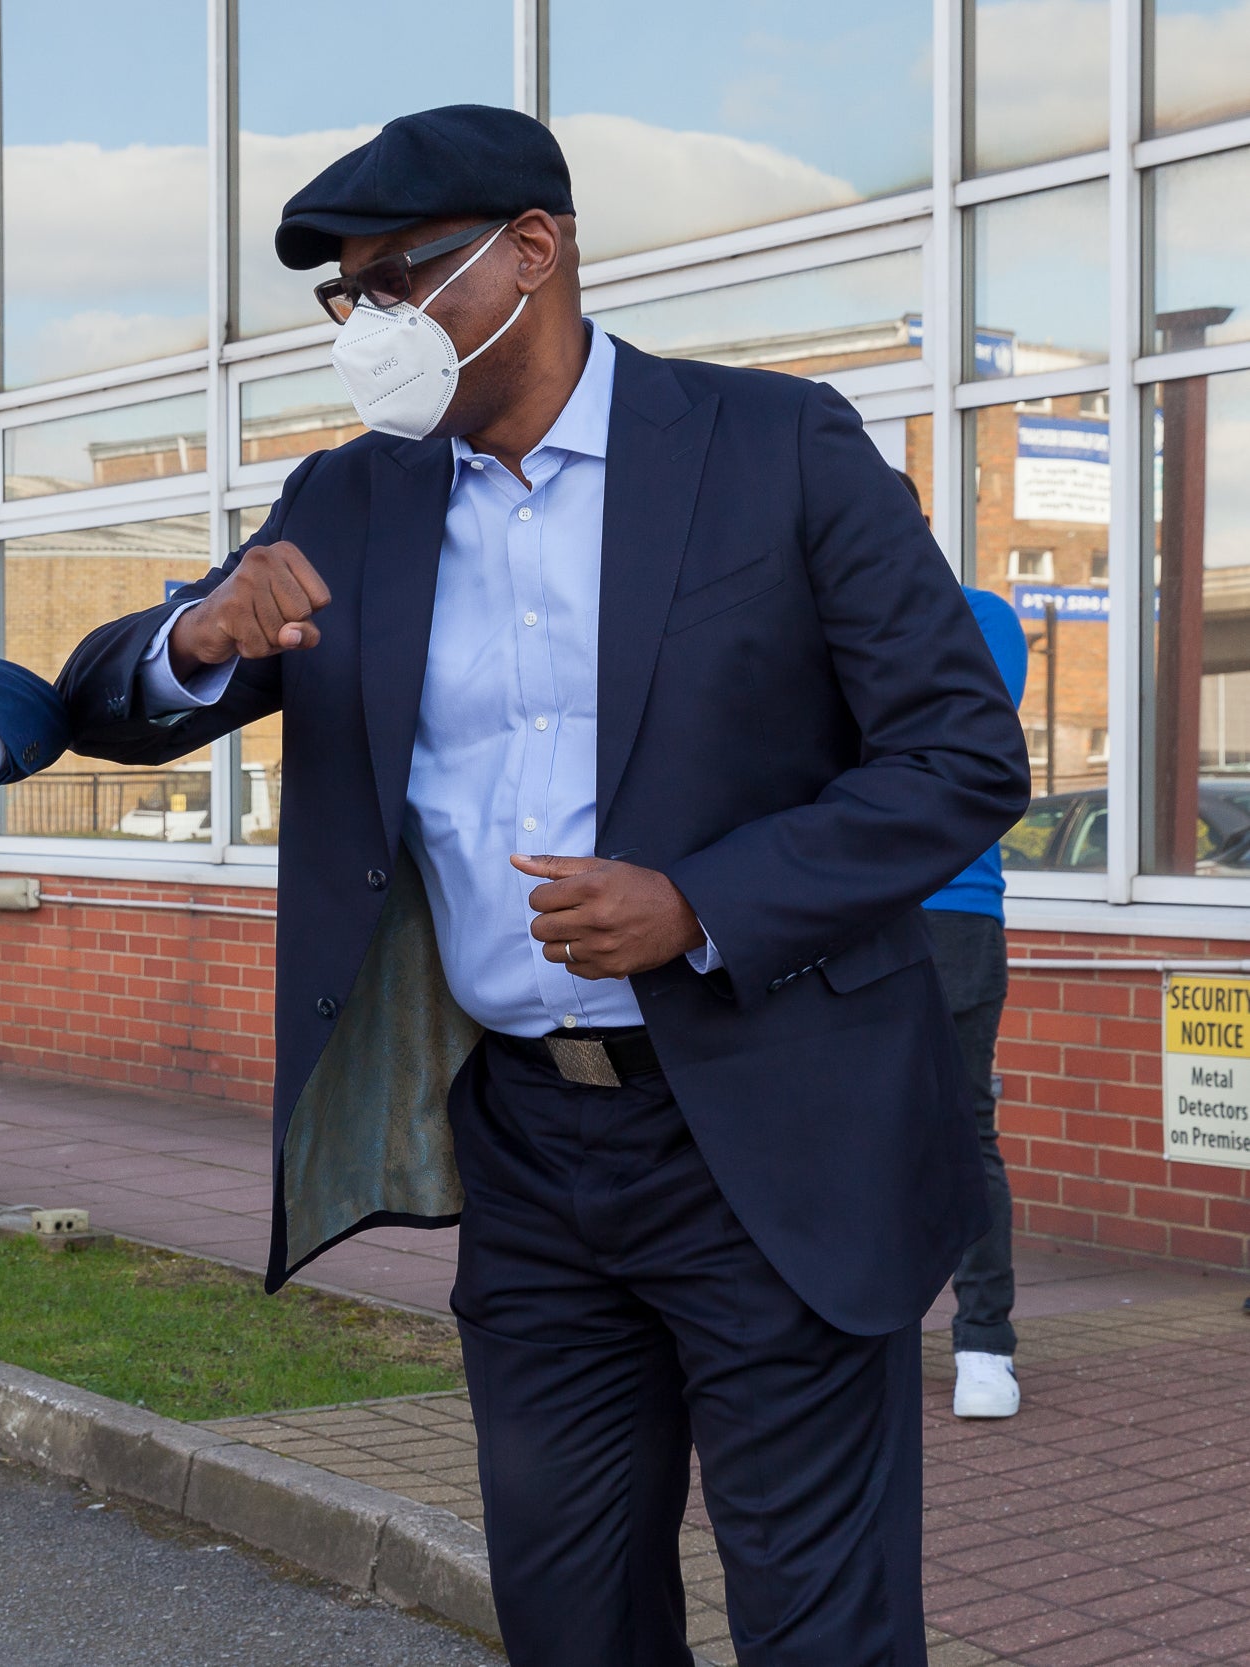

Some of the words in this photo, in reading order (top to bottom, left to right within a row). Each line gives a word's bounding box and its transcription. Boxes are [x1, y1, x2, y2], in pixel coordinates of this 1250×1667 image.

[371, 356, 399, 378] KN95
[1182, 1021, 1244, 1049] NOTICE
[1191, 1066, 1233, 1089] Metal
[1178, 1095, 1249, 1121] Detectors
[1171, 1129, 1189, 1145] on
